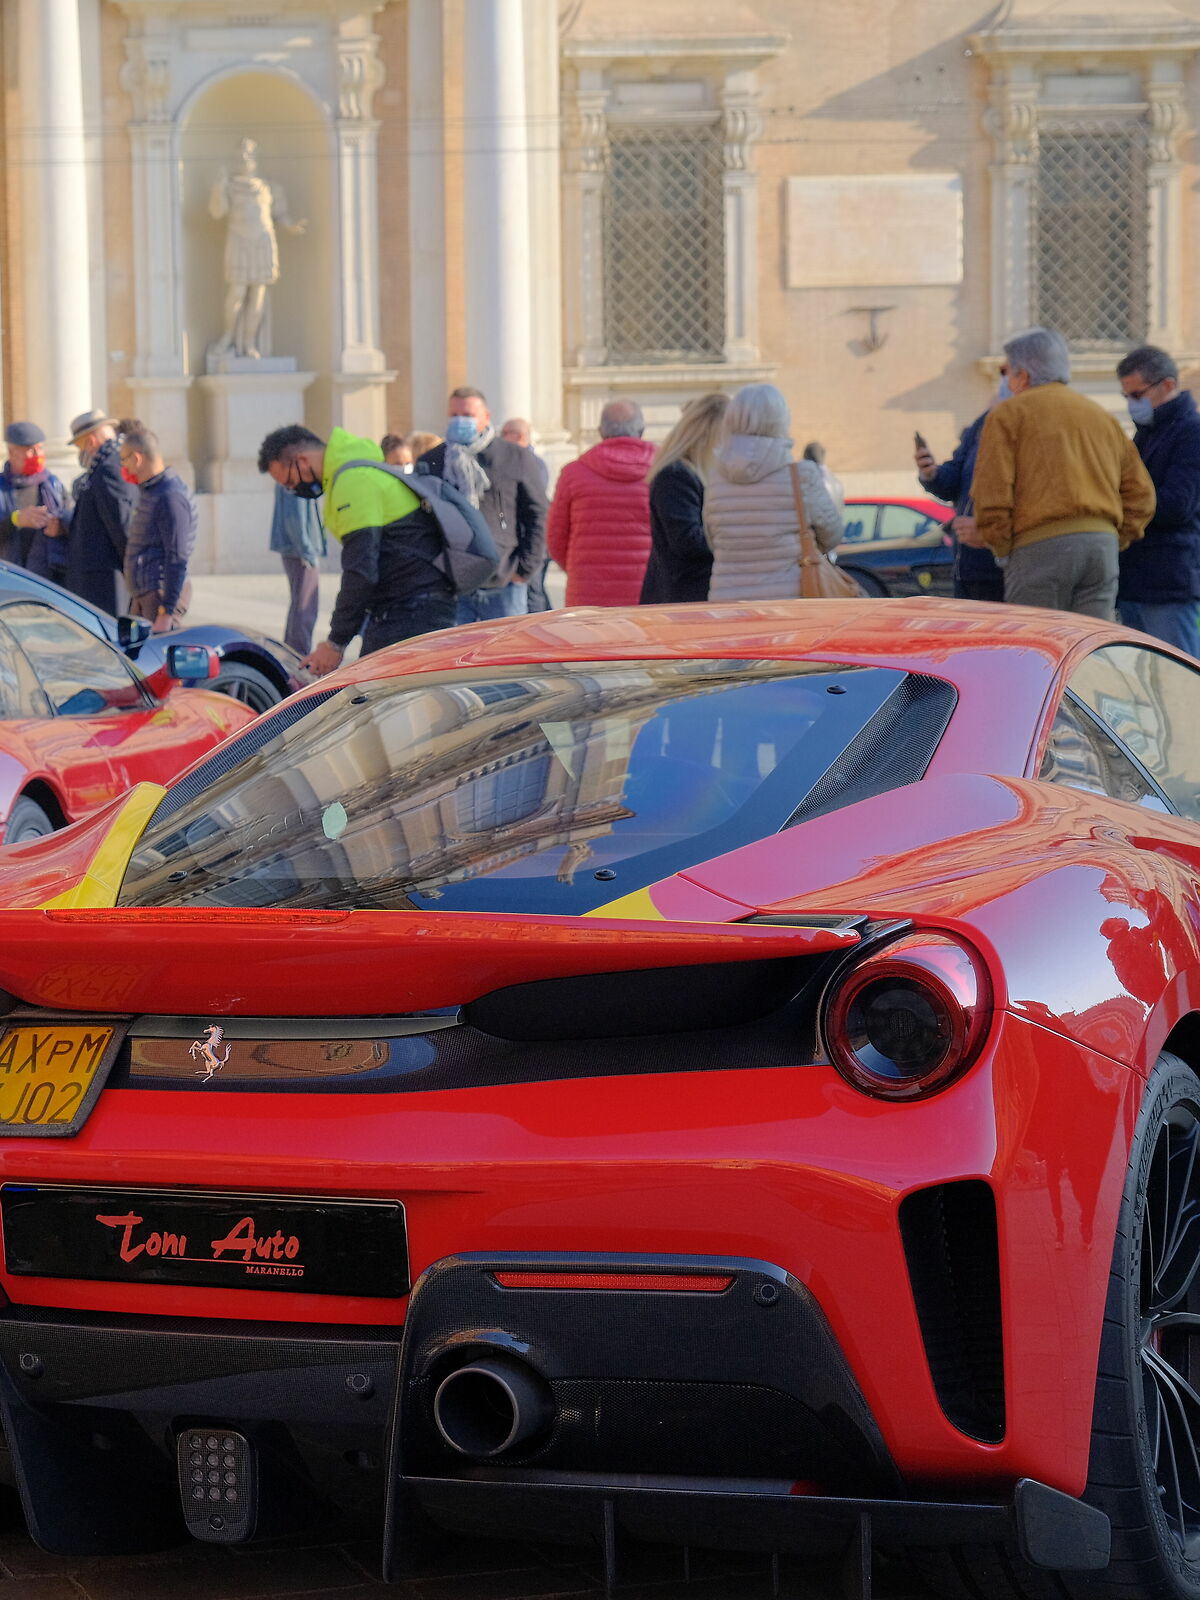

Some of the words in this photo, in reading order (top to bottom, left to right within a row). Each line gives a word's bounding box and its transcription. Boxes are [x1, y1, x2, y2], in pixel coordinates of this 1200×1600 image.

[95, 1211, 188, 1263] Toni
[211, 1216, 300, 1262] Auto
[246, 1266, 305, 1277] MARANELLO
